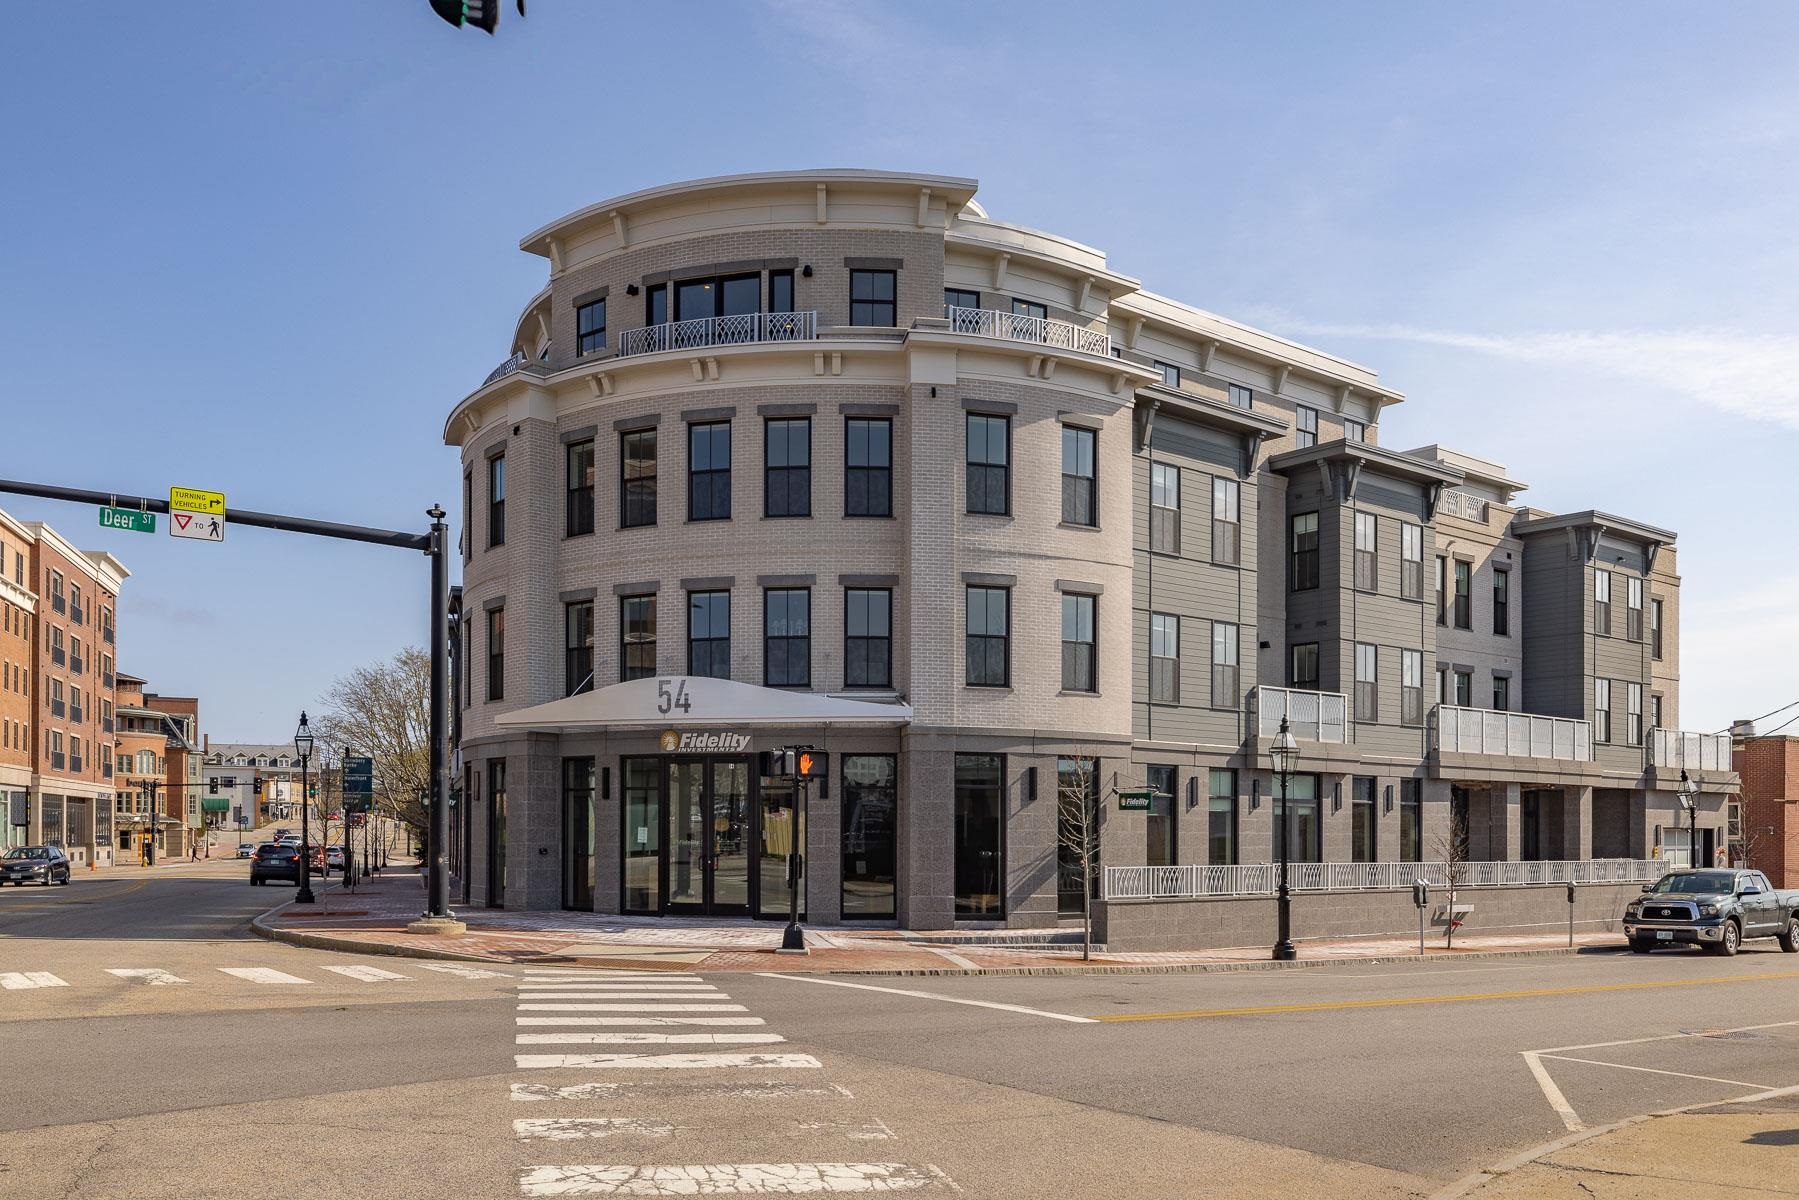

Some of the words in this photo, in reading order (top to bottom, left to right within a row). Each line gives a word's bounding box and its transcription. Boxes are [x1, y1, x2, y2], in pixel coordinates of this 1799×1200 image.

[175, 491, 206, 501] TURNING
[174, 500, 207, 510] VEHICLES
[104, 509, 135, 529] Deer
[142, 514, 152, 525] ST
[194, 522, 204, 530] TO
[657, 679, 691, 714] 54
[679, 732, 752, 752] Fidelity
[1126, 797, 1150, 807] Fidelity
